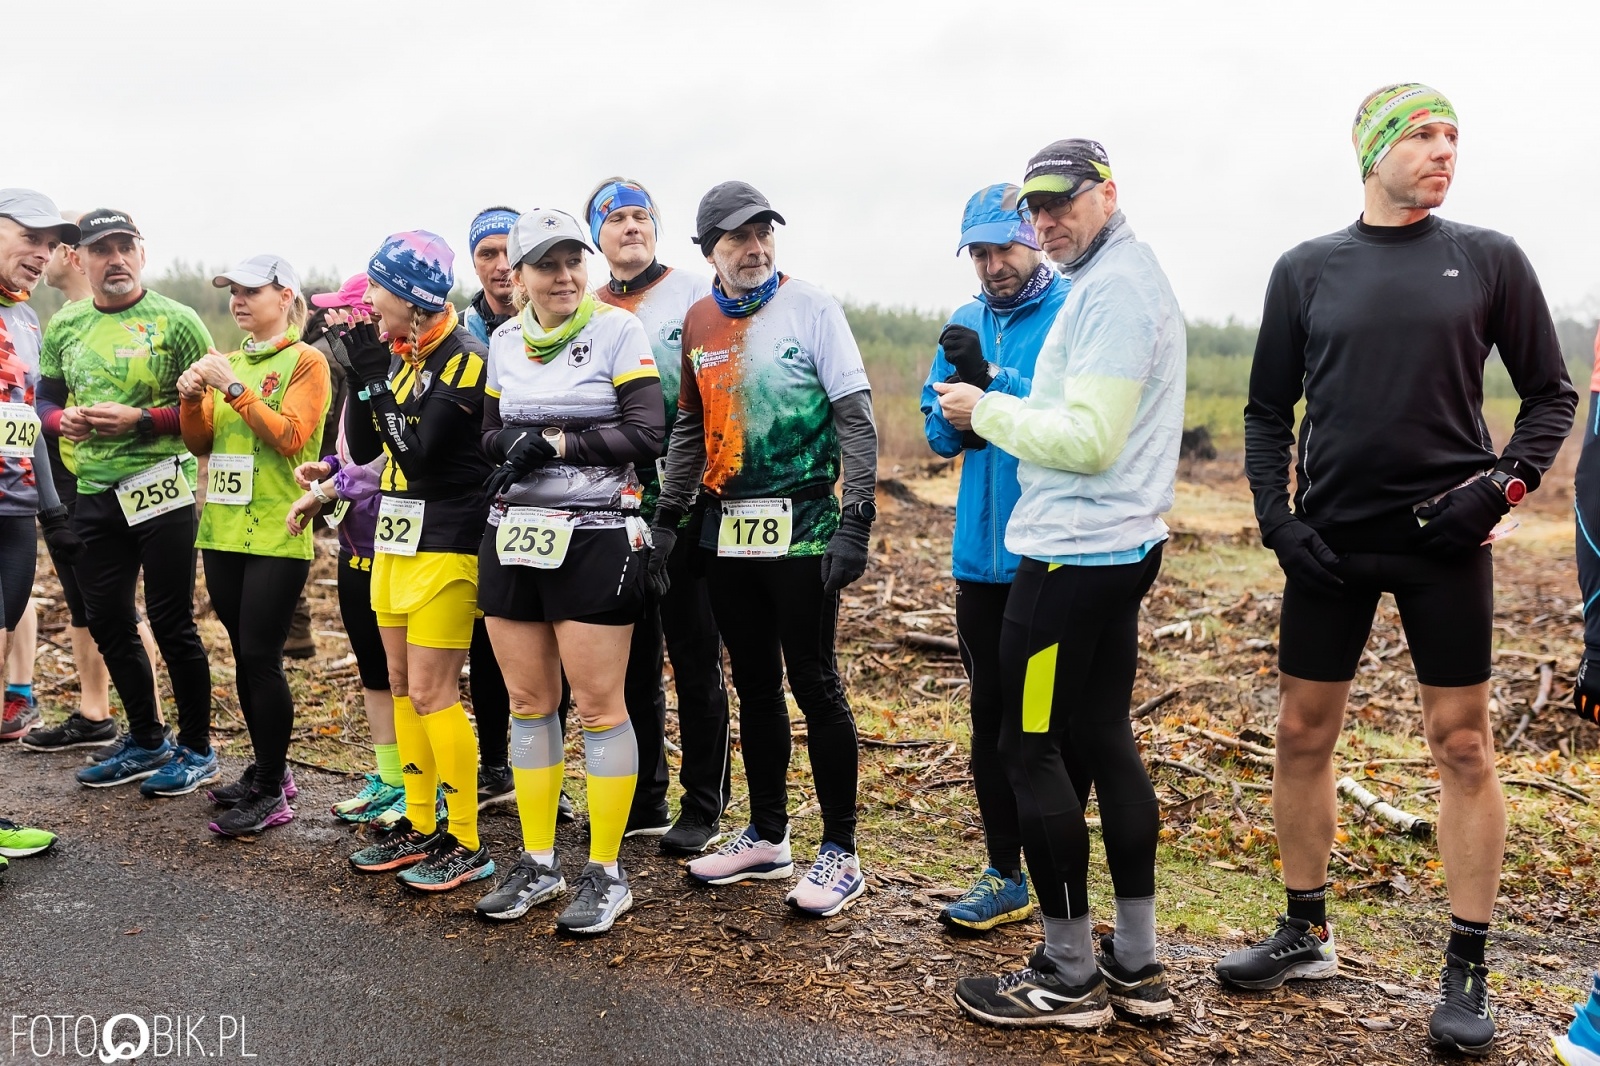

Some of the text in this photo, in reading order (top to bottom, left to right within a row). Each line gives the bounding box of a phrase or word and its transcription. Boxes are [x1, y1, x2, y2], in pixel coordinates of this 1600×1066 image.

[5, 421, 36, 447] 243
[384, 412, 409, 452] Rogelli
[130, 478, 180, 512] 258
[213, 470, 242, 494] 155
[375, 516, 412, 543] 32
[503, 526, 556, 556] 253
[733, 518, 779, 545] 178
